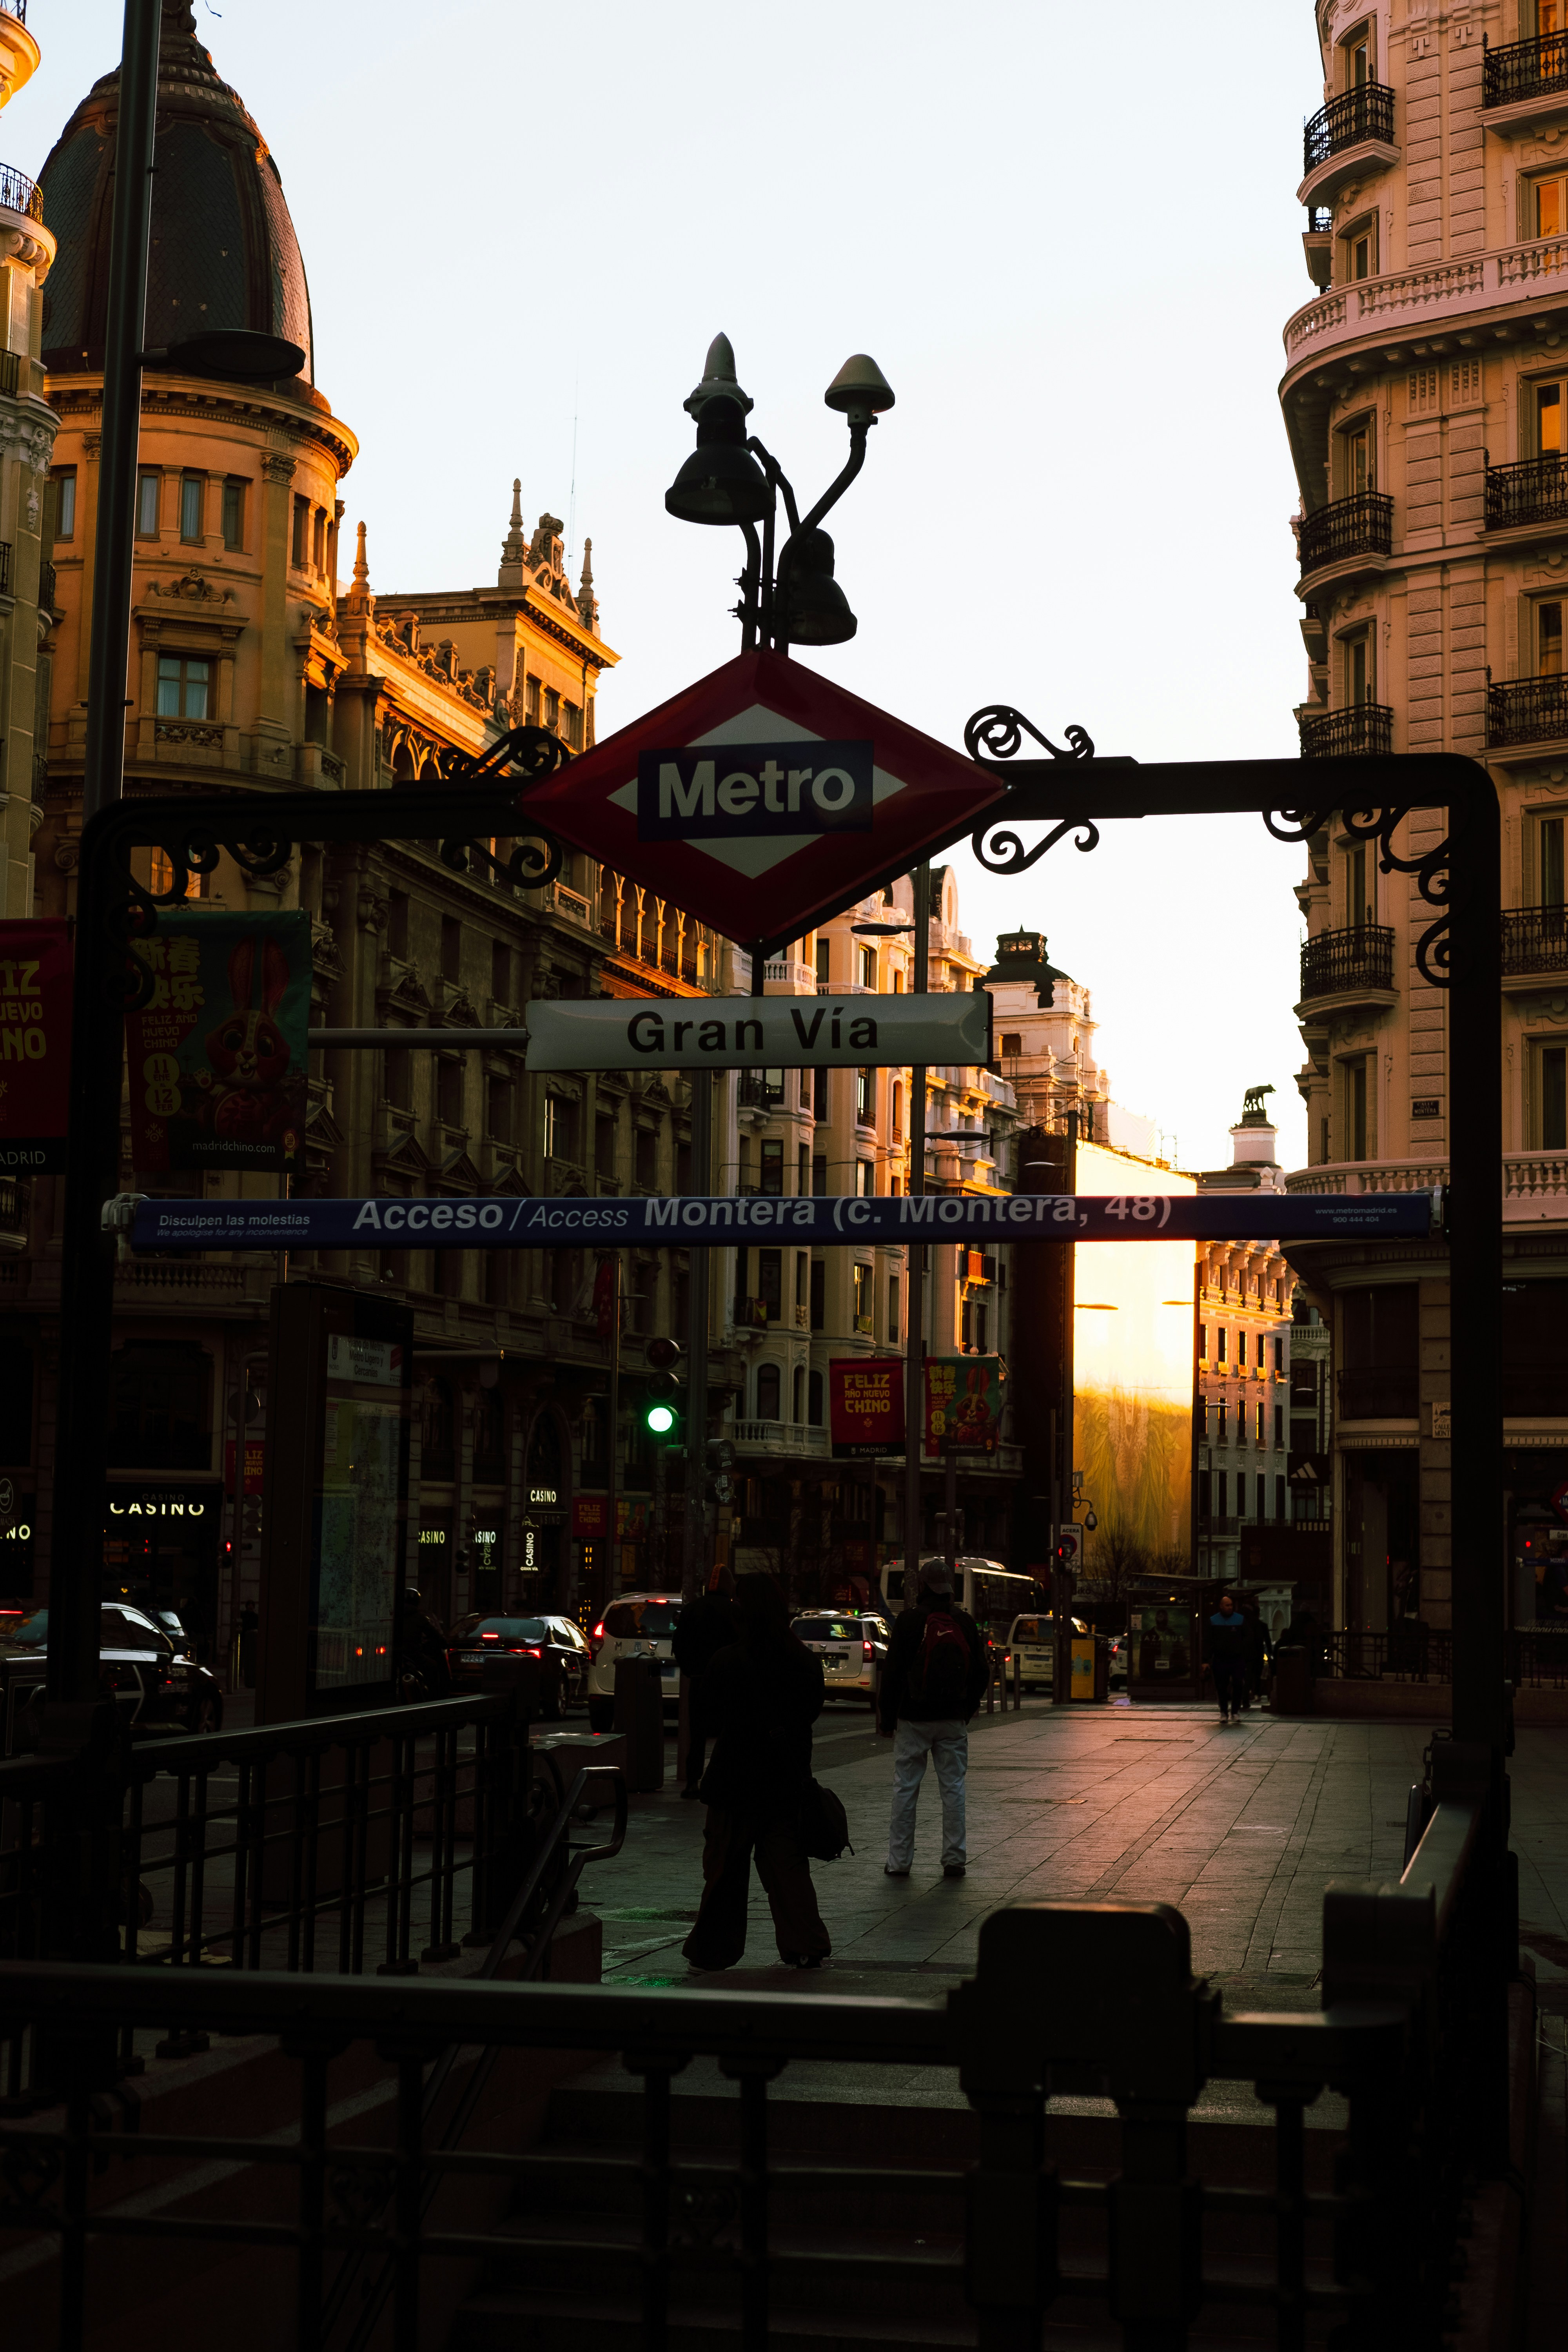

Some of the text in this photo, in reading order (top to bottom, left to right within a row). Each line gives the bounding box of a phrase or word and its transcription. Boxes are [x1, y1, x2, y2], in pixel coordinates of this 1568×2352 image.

[659, 760, 855, 818] Metro
[142, 1011, 198, 1025] FELIZ AÑO
[142, 1026, 180, 1037] NUEVO
[628, 1007, 878, 1053] Gran Vía
[144, 1038, 178, 1049] CHINO
[154, 1059, 169, 1073] 11
[154, 1089, 173, 1104] 12
[192, 1140, 275, 1153] madridchino.com
[353, 1201, 503, 1229] Acceso
[527, 1205, 628, 1227] Access
[644, 1198, 815, 1226] Montera
[833, 1198, 881, 1231] (c.
[900, 1196, 1088, 1227] Montera,
[1104, 1196, 1171, 1228] 48)
[159, 1214, 310, 1228] Disculpen las molestias
[171, 1229, 214, 1238] apologise
[363, 1339, 369, 1349] de
[349, 1350, 364, 1362] Metro
[365, 1353, 379, 1366] Ligero
[354, 1364, 378, 1378] Cercanías
[844, 1374, 890, 1388] FELIZ
[845, 1389, 890, 1398] AÑO NUEVO
[845, 1399, 890, 1413] CHINO
[530, 1490, 557, 1503] CASINO
[110, 1503, 204, 1516] CASINO
[526, 1532, 534, 1566] CASINO
[615, 1641, 622, 1651] M
